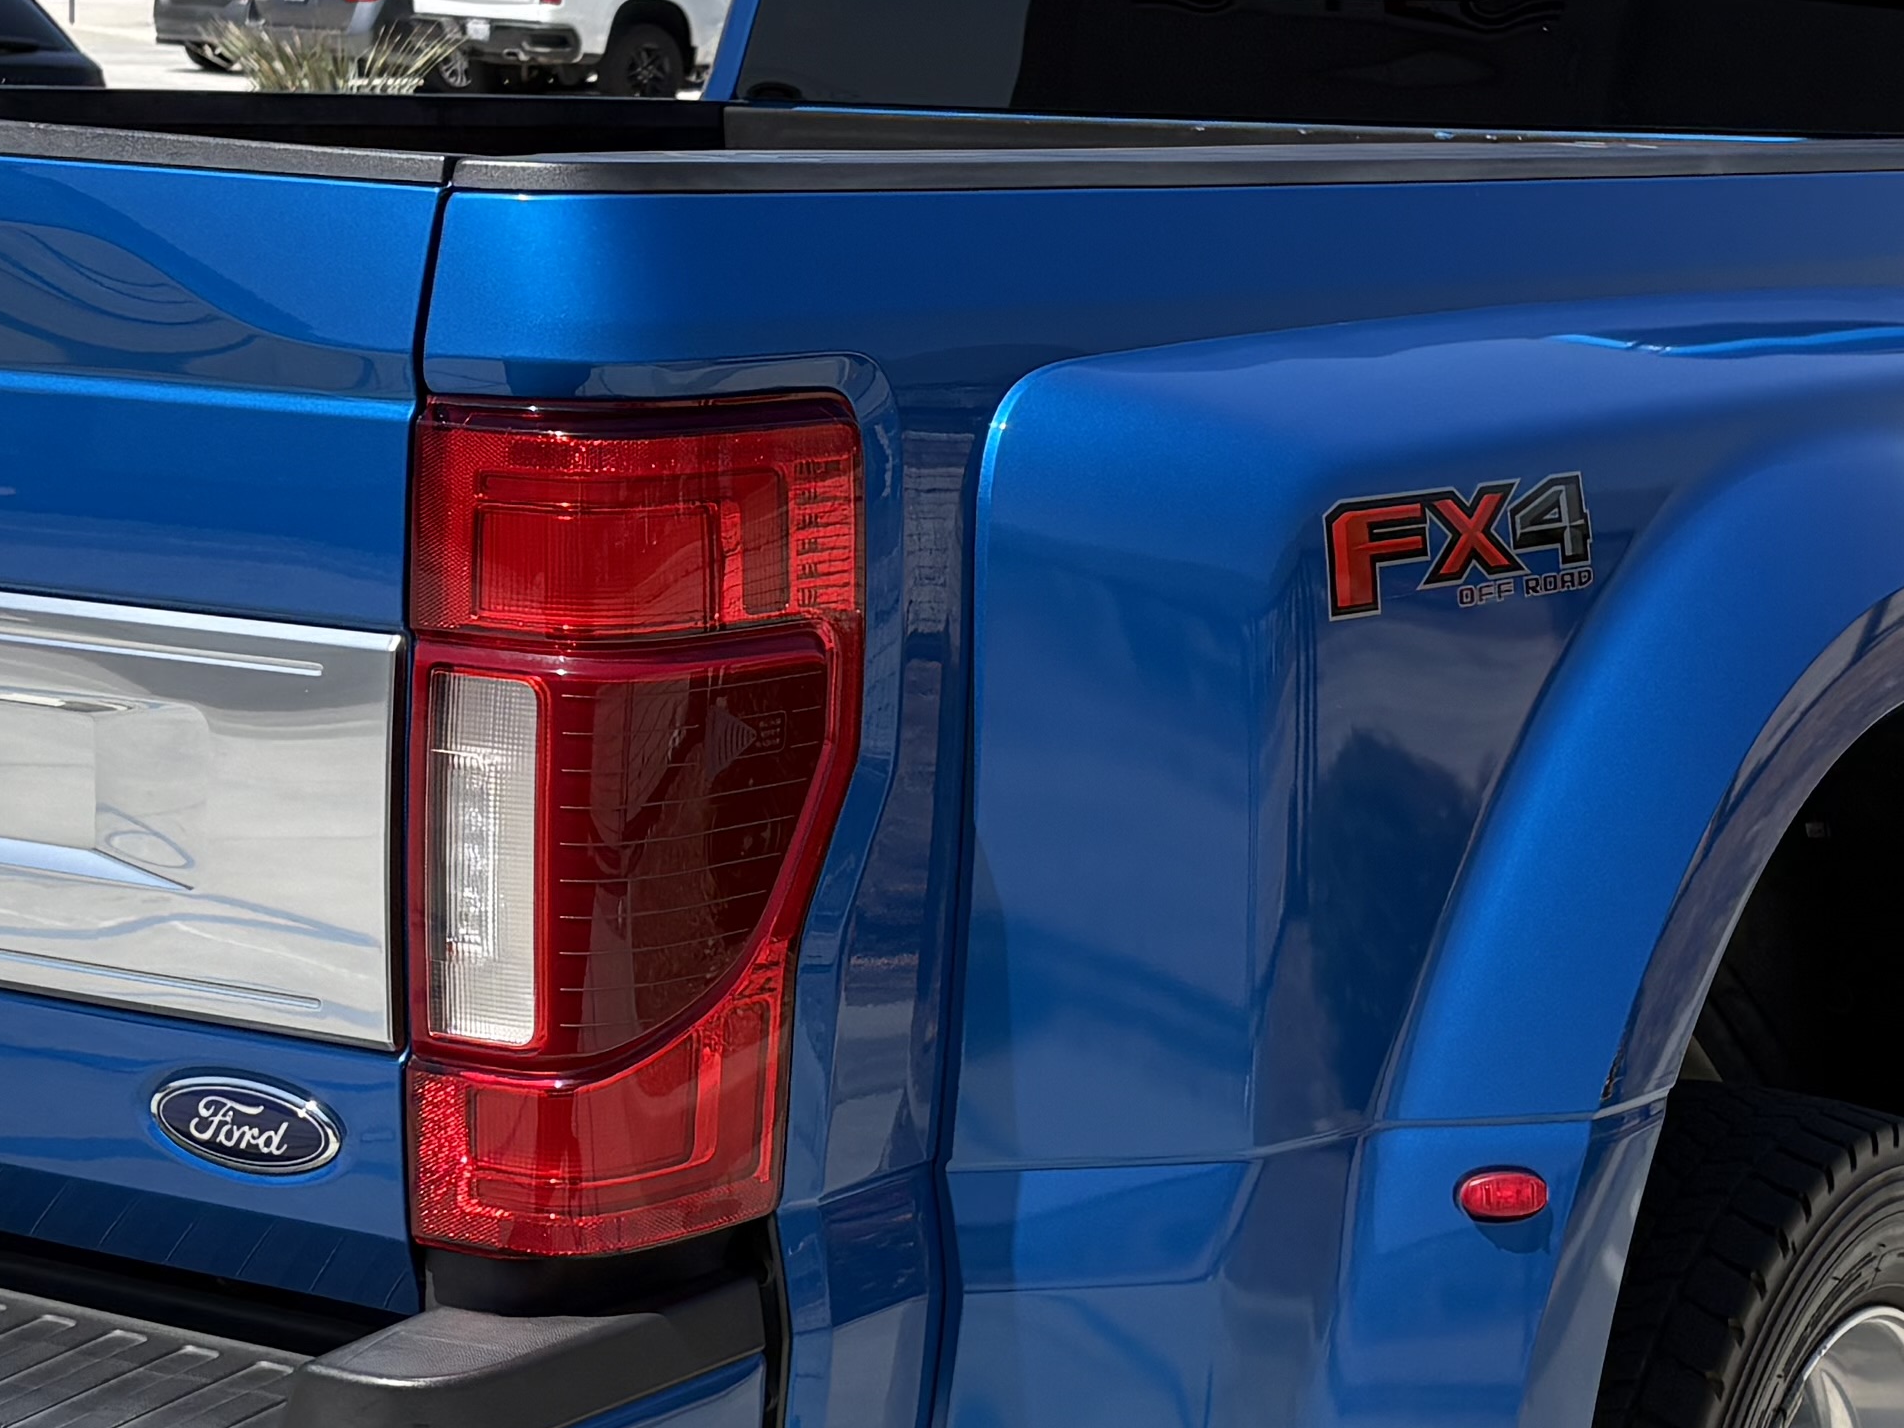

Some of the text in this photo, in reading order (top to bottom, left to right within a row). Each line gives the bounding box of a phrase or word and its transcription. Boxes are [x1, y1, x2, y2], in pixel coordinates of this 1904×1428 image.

[1322, 471, 1593, 621] FX4
[1457, 567, 1593, 608] OFF ROAD
[189, 1095, 289, 1155] Ford
